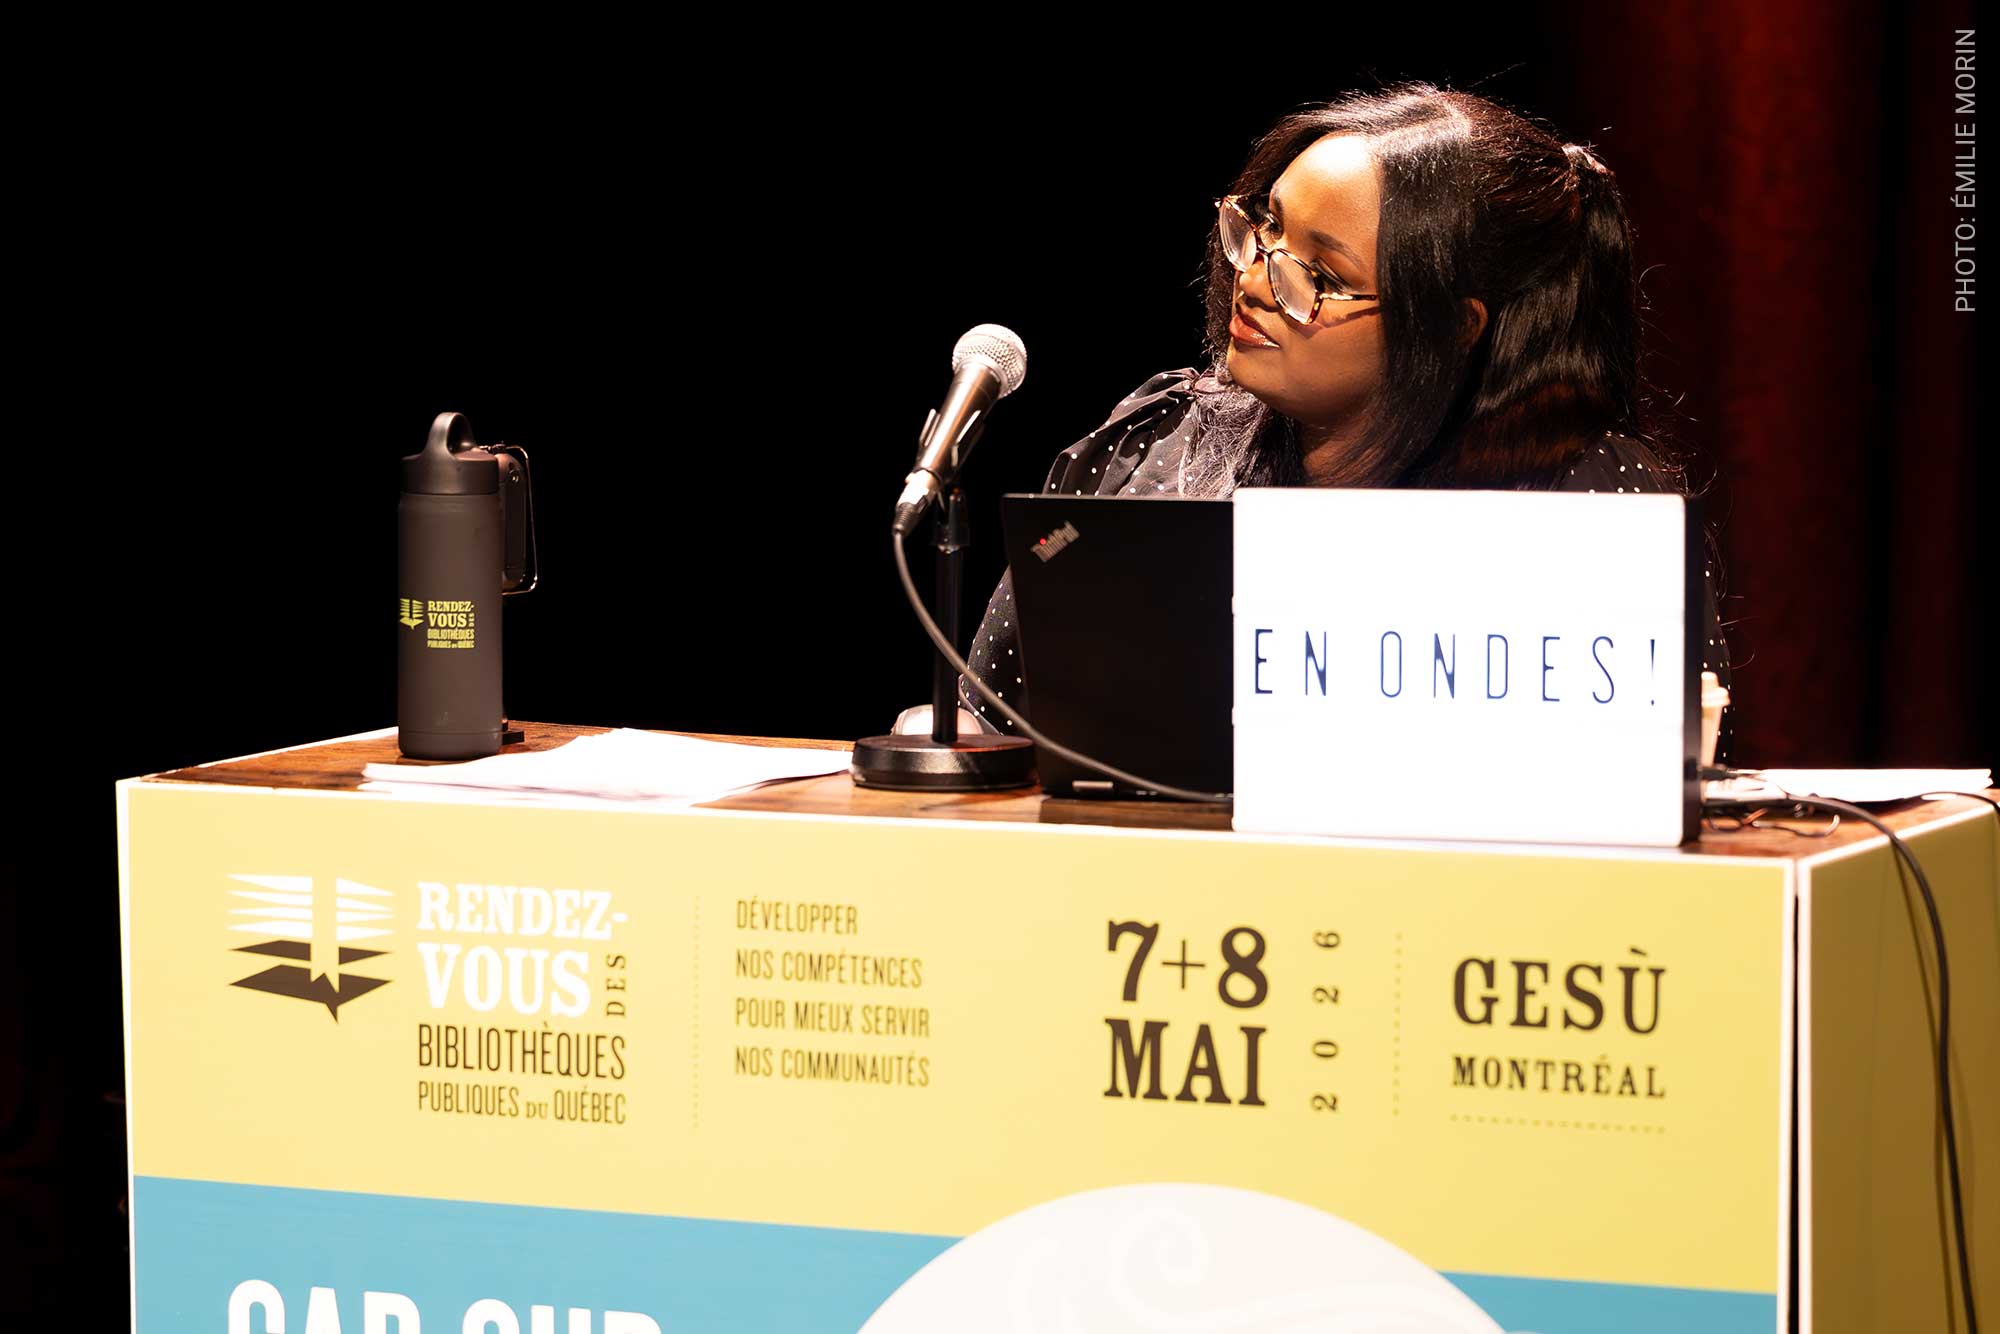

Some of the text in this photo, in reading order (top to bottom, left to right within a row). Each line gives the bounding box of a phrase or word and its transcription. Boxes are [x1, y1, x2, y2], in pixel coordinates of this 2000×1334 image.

[428, 600, 475, 612] RENDEZ-
[428, 613, 467, 628] VOUS
[1254, 628, 1328, 697] EN
[416, 881, 629, 940] RENDEZ-
[736, 894, 858, 935] DÉVELOPPER
[416, 942, 591, 1018] VOUS
[606, 953, 626, 1017] DES
[735, 948, 923, 989] NOS COMPÉTENCES
[1451, 947, 1667, 1036] GESÙ
[735, 997, 931, 1037] POUR MIEUX SERVIR
[1311, 929, 1342, 1113] 2026
[418, 1021, 626, 1080] BIBLIOTHÈQUES
[735, 1046, 930, 1087] NOS COMMUNAUTÉS
[1103, 1017, 1267, 1107] MAI
[1451, 1053, 1667, 1099] MONTRÉAL
[418, 1080, 520, 1118] PUBLIQUES
[553, 1085, 627, 1124] QUÉBEC
